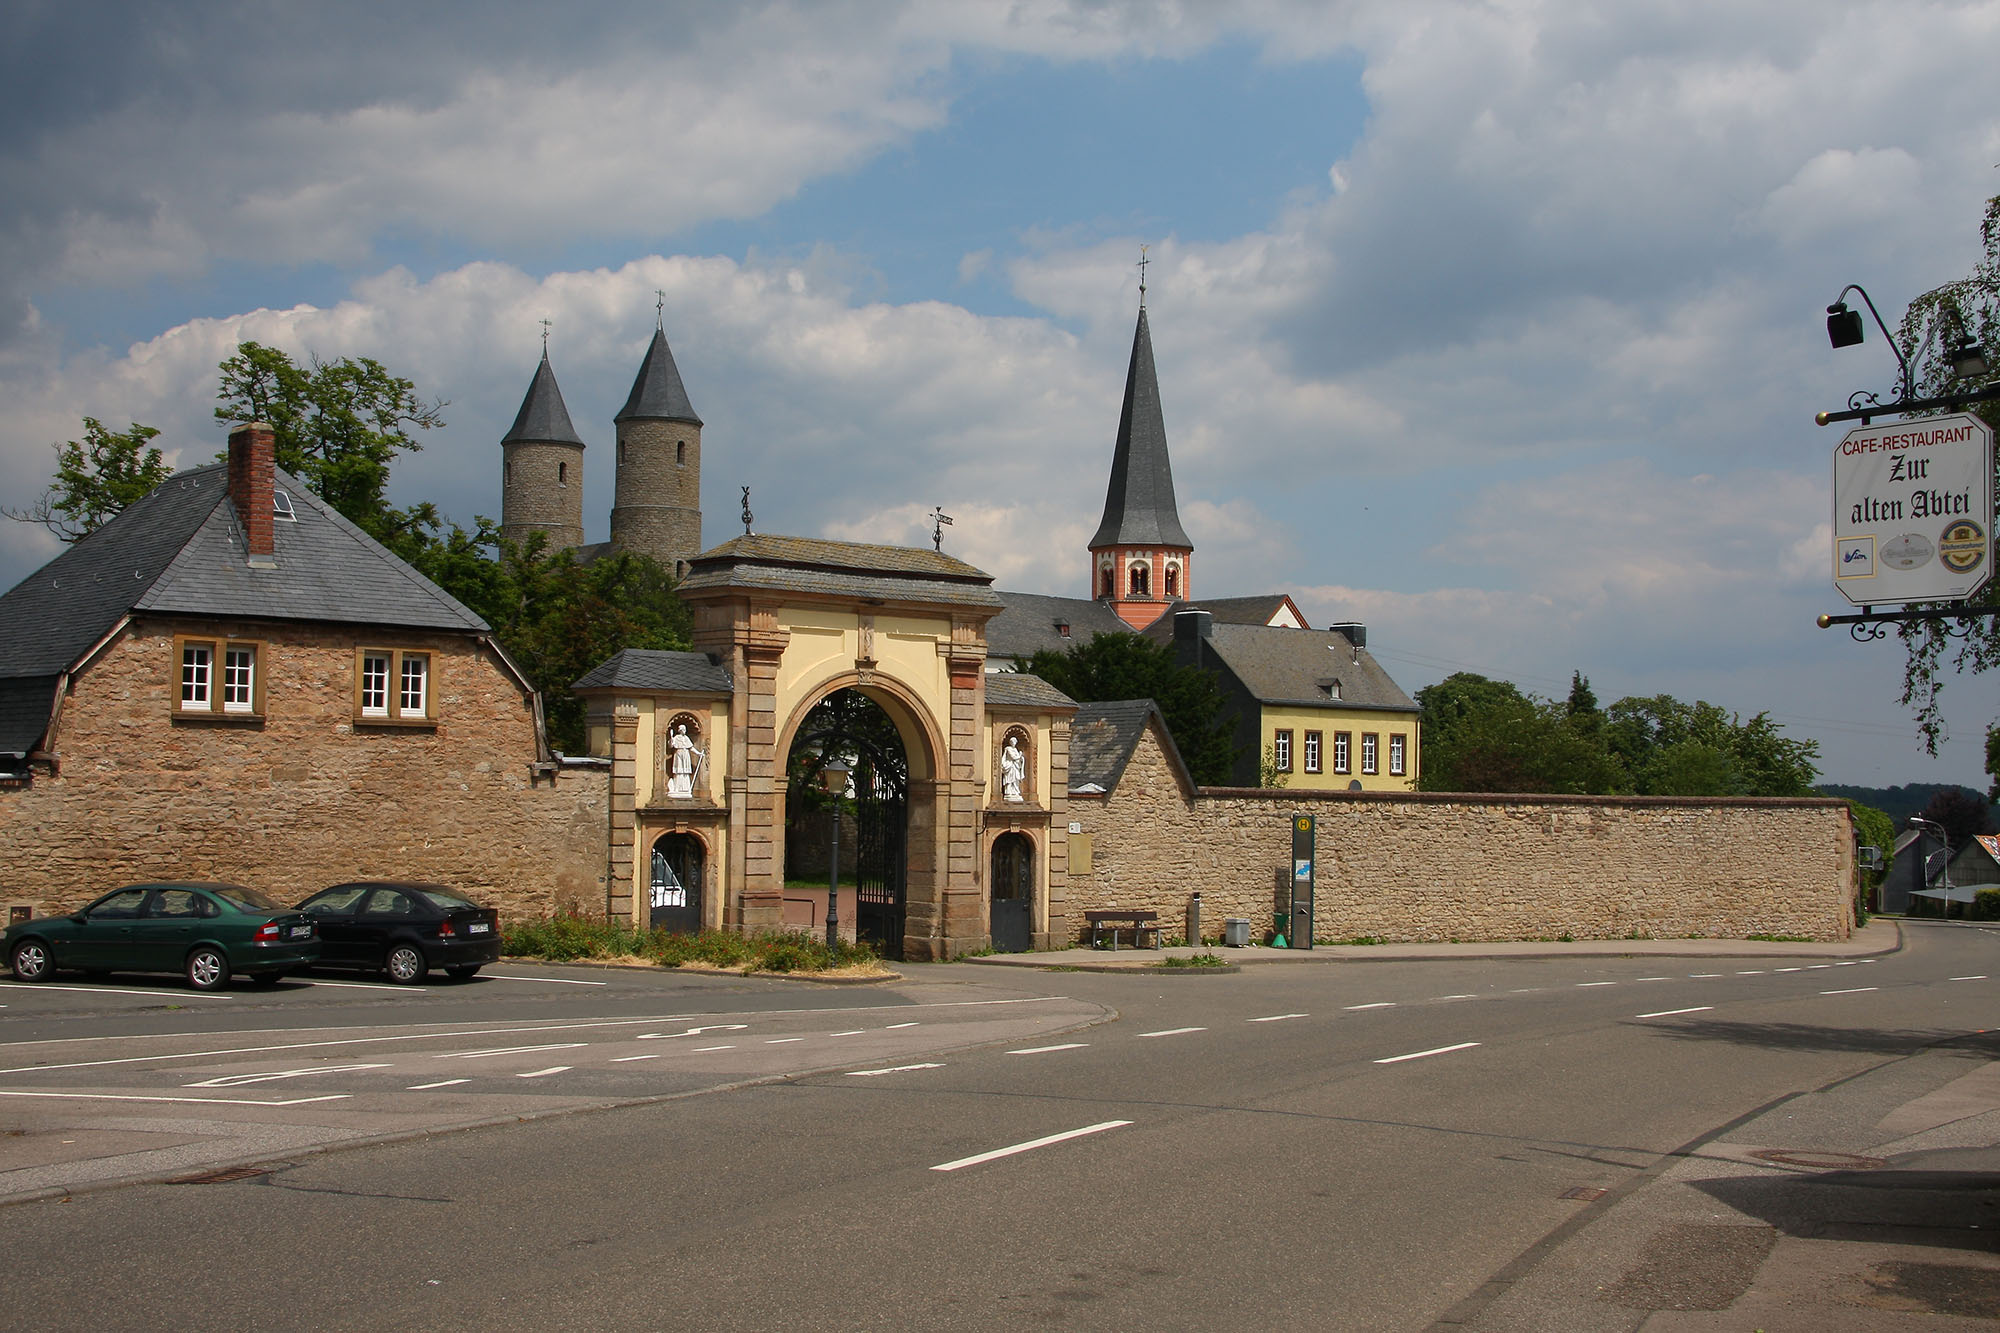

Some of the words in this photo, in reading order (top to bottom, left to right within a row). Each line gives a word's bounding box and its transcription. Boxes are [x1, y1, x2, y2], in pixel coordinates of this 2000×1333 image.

[1842, 426, 1974, 456] CAFE-RESTAURANT
[1888, 454, 1930, 482] Zur
[1851, 496, 1904, 524] alten
[1910, 486, 1970, 519] Abtei
